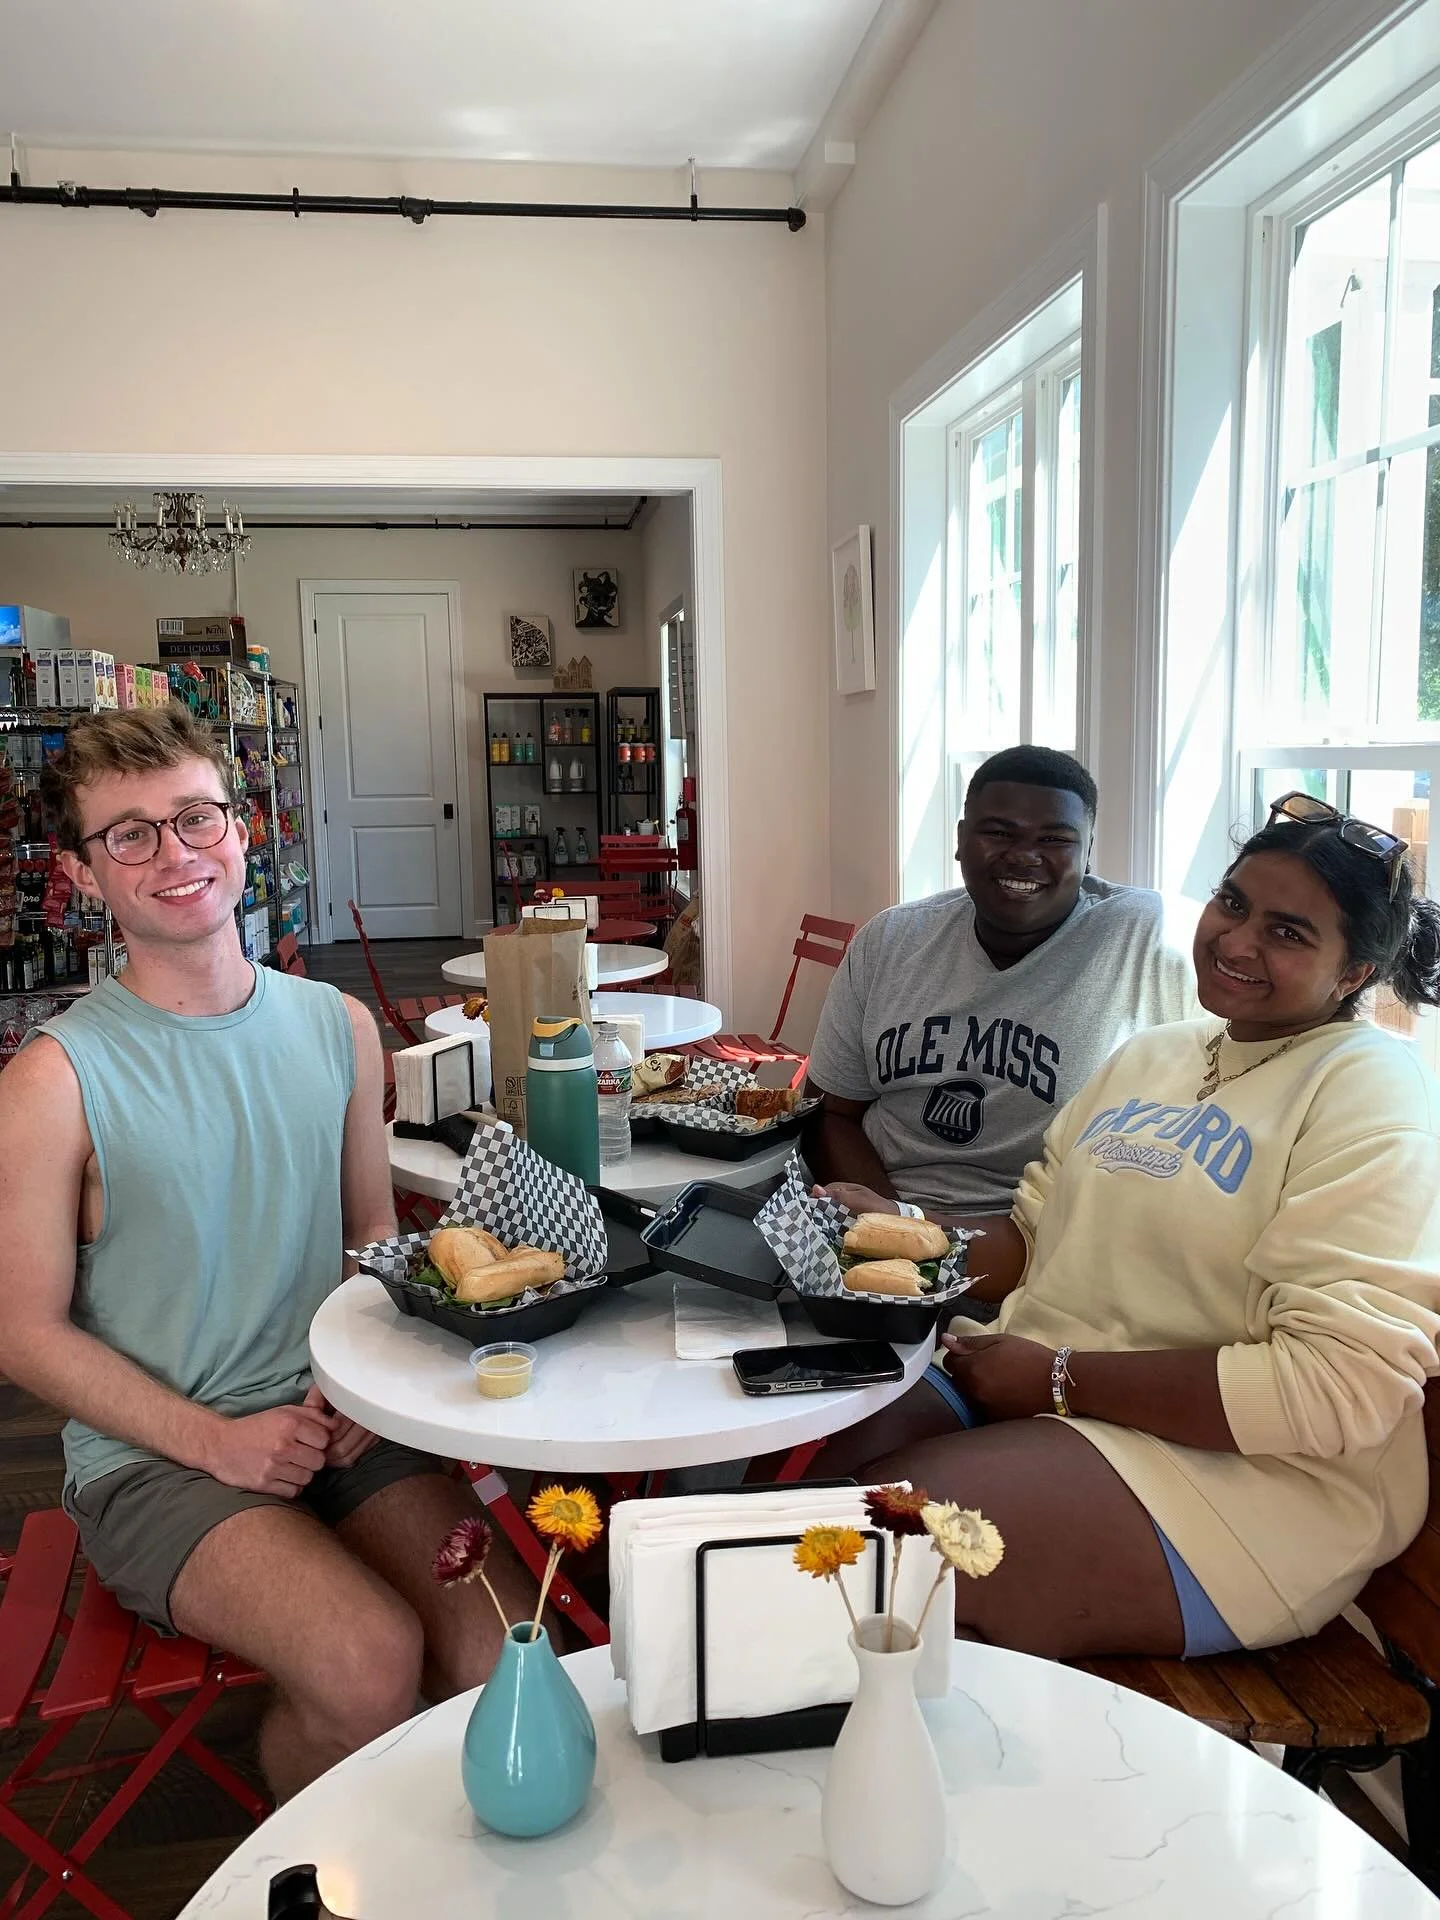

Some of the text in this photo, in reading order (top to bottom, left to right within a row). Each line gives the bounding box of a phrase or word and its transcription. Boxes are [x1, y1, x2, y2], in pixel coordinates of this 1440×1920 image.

[170, 645, 221, 653] DELICIOUS
[876, 1016, 1060, 1104] OLE MISS
[597, 1078, 620, 1086] ZARKA
[1073, 1099, 1252, 1194] OXFORD
[1089, 1136, 1183, 1170] Mississippi
